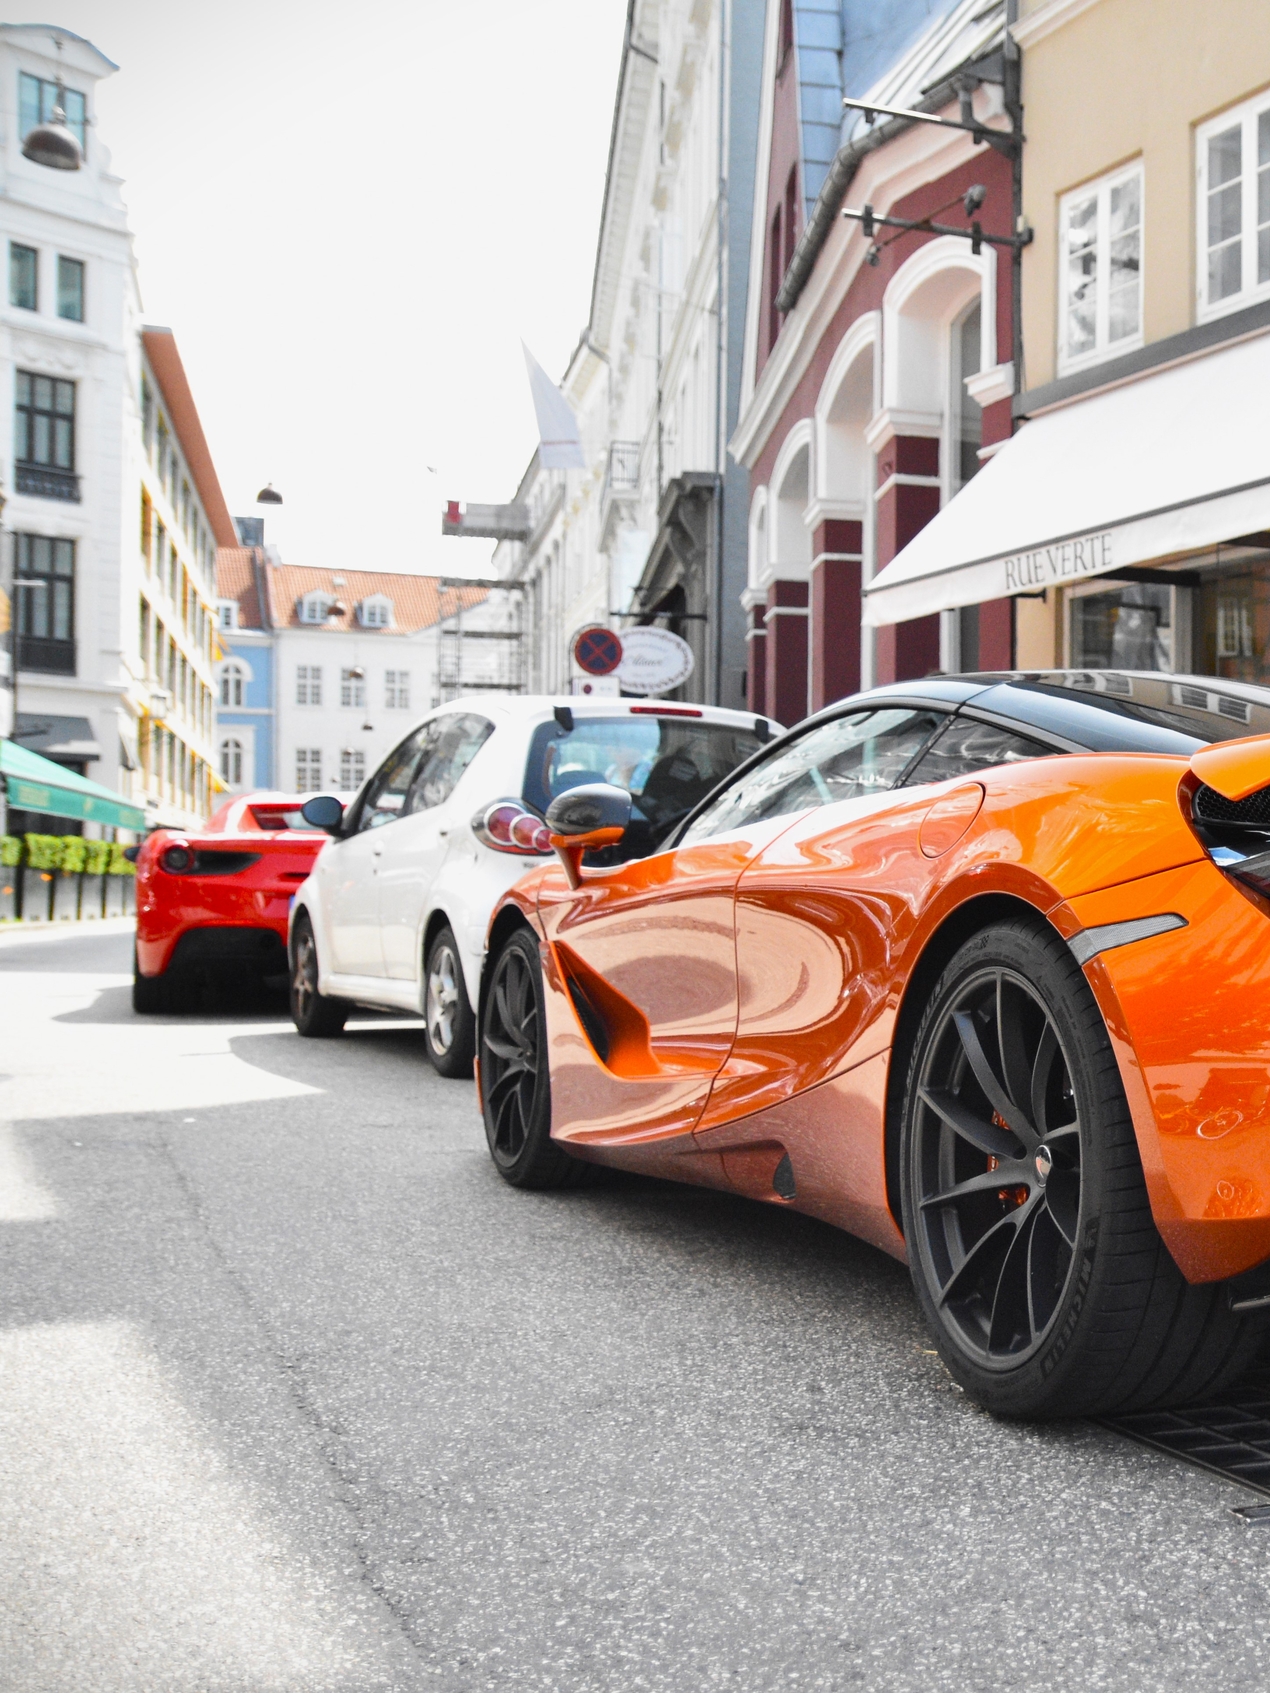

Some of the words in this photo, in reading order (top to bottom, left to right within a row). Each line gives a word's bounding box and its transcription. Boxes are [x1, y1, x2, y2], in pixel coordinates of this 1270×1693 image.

[1004, 549, 1045, 590] RUE
[1045, 531, 1112, 577] VERTE
[1042, 1257, 1093, 1377] MICHELIN
